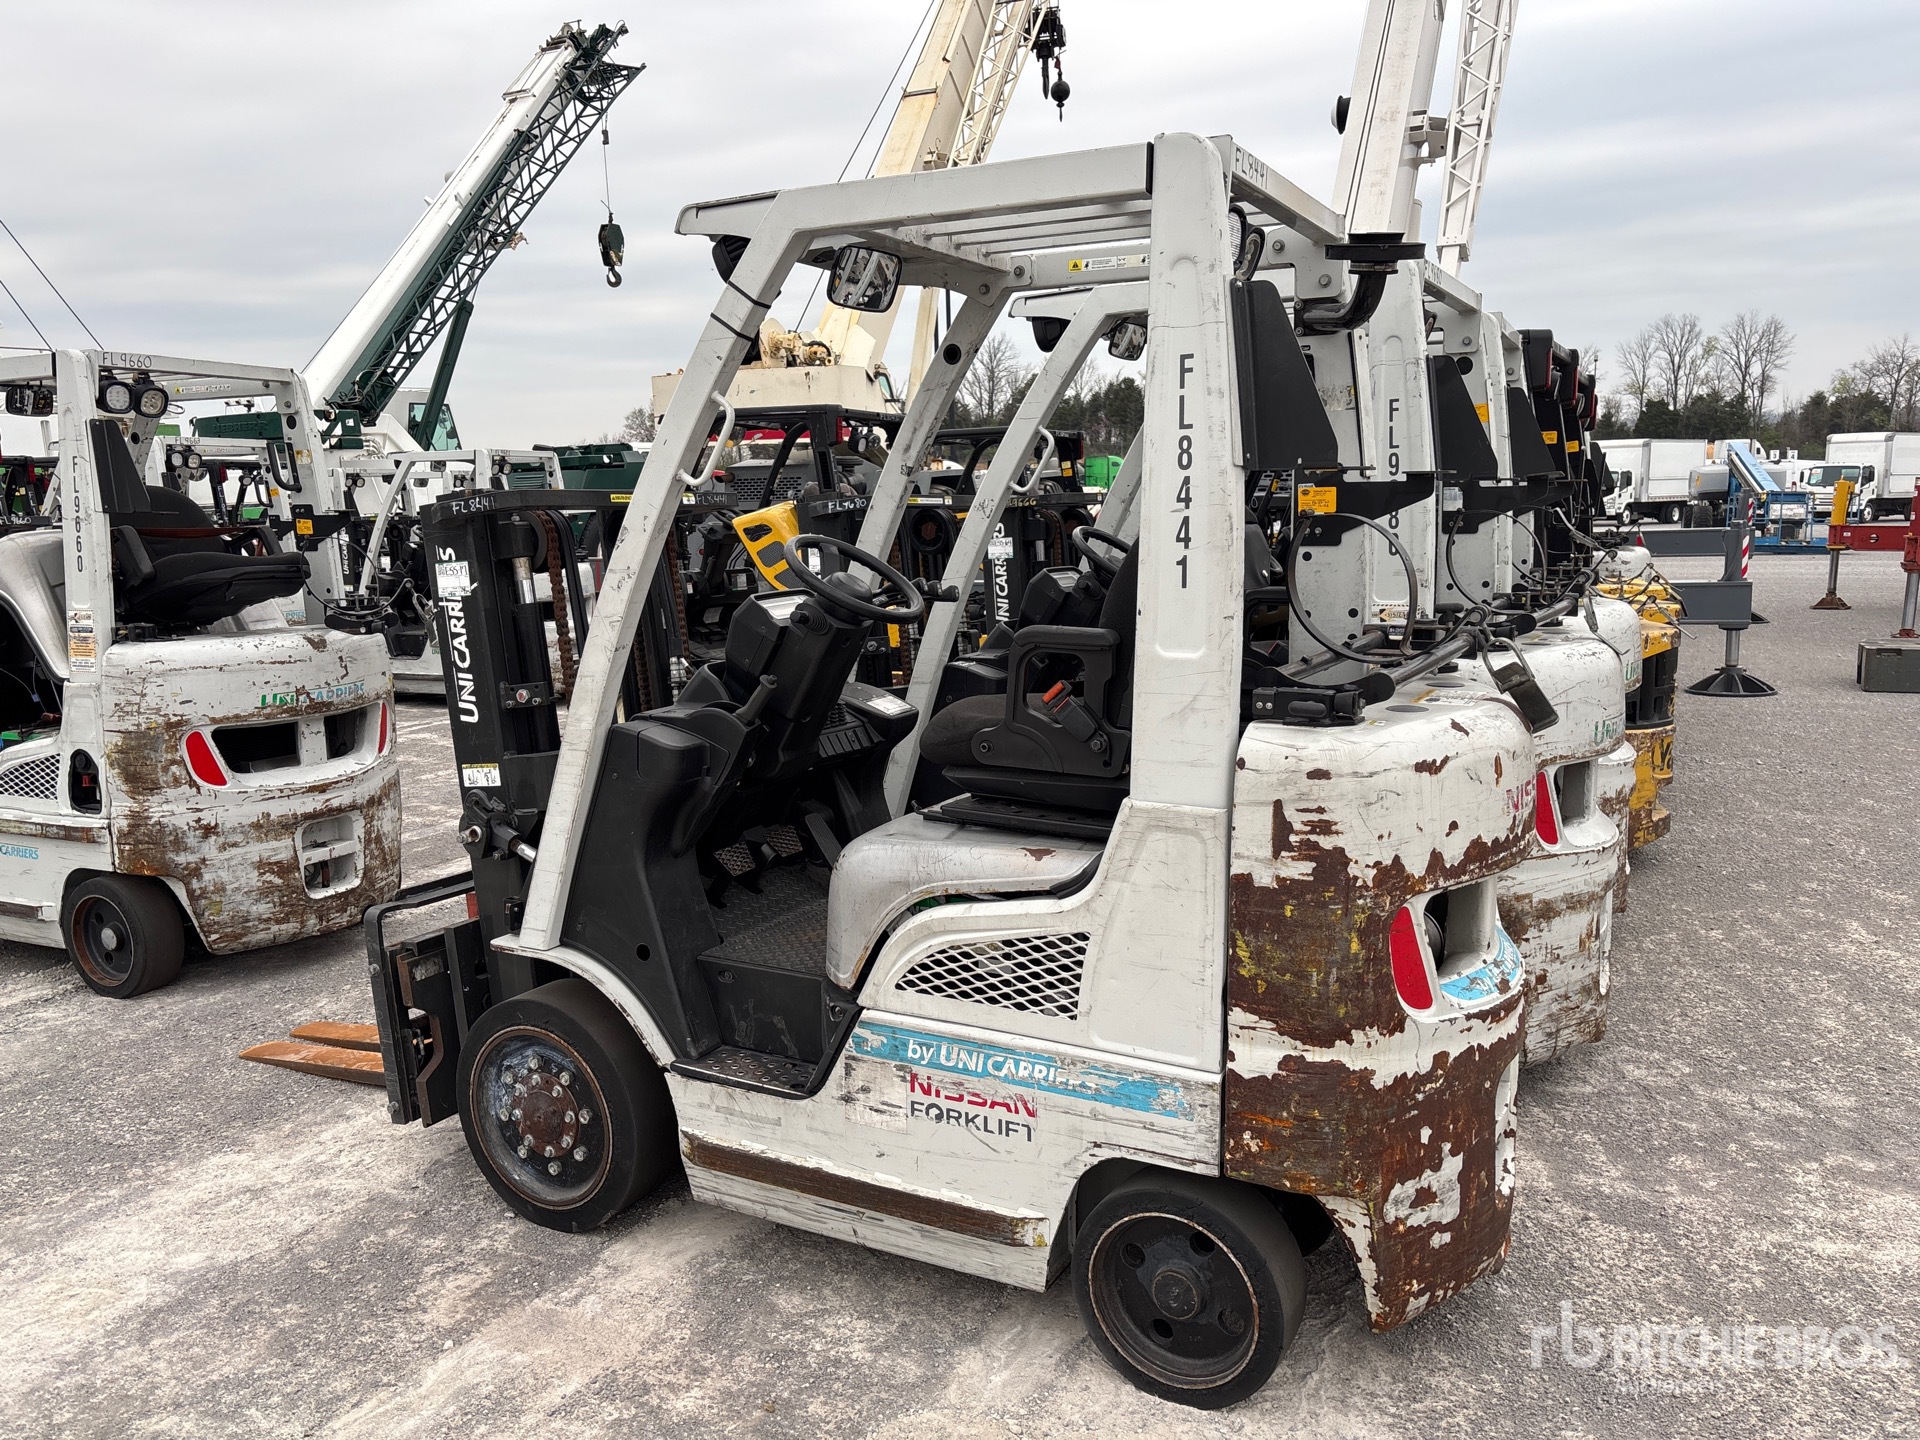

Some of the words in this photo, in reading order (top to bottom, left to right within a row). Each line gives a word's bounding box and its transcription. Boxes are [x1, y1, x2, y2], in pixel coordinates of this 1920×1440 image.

[1235, 147, 1269, 190] FL8441
[102, 352, 152, 367] FL9660
[1175, 353, 1195, 589] FL8441
[1388, 398, 1400, 557] FL980
[72, 456, 84, 573] FL9660
[452, 497, 495, 514] FL8441
[908, 1040, 935, 1065] by
[910, 1072, 1037, 1118] NISSAN
[910, 1100, 1033, 1142] FORKLIFT
